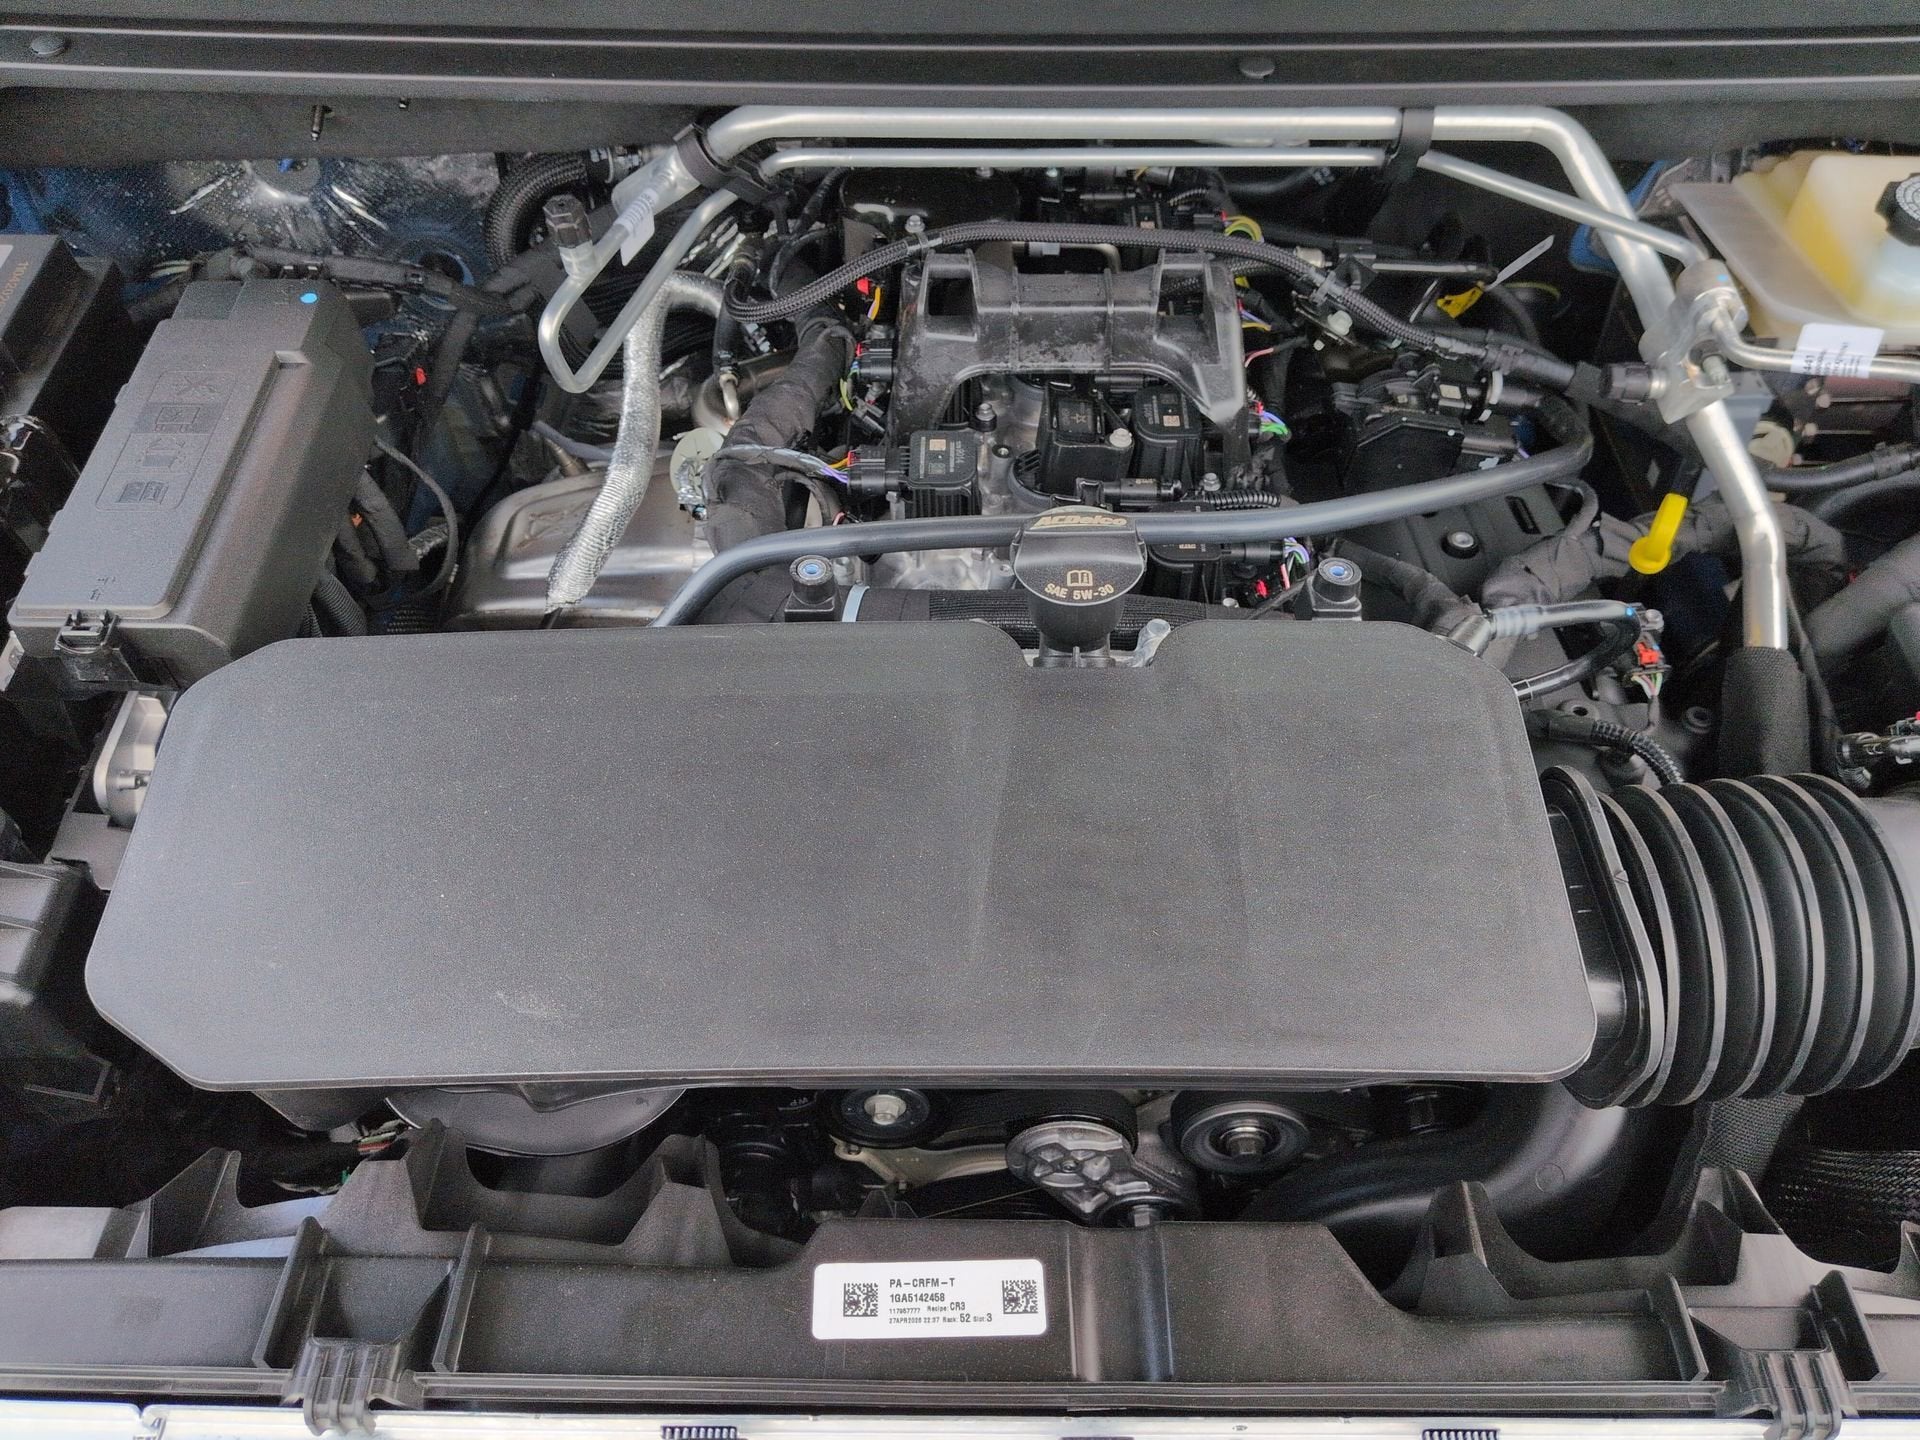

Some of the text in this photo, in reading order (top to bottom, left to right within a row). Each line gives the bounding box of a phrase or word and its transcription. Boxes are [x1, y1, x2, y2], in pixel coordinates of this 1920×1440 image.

[1035, 515, 1127, 526] ACDelco
[1044, 583, 1115, 600] SAE 5W-30
[889, 1293, 945, 1303] 1GA5142458
[949, 1301, 966, 1311] CR3
[959, 1313, 971, 1323] 52
[986, 1312, 993, 1323] 3
